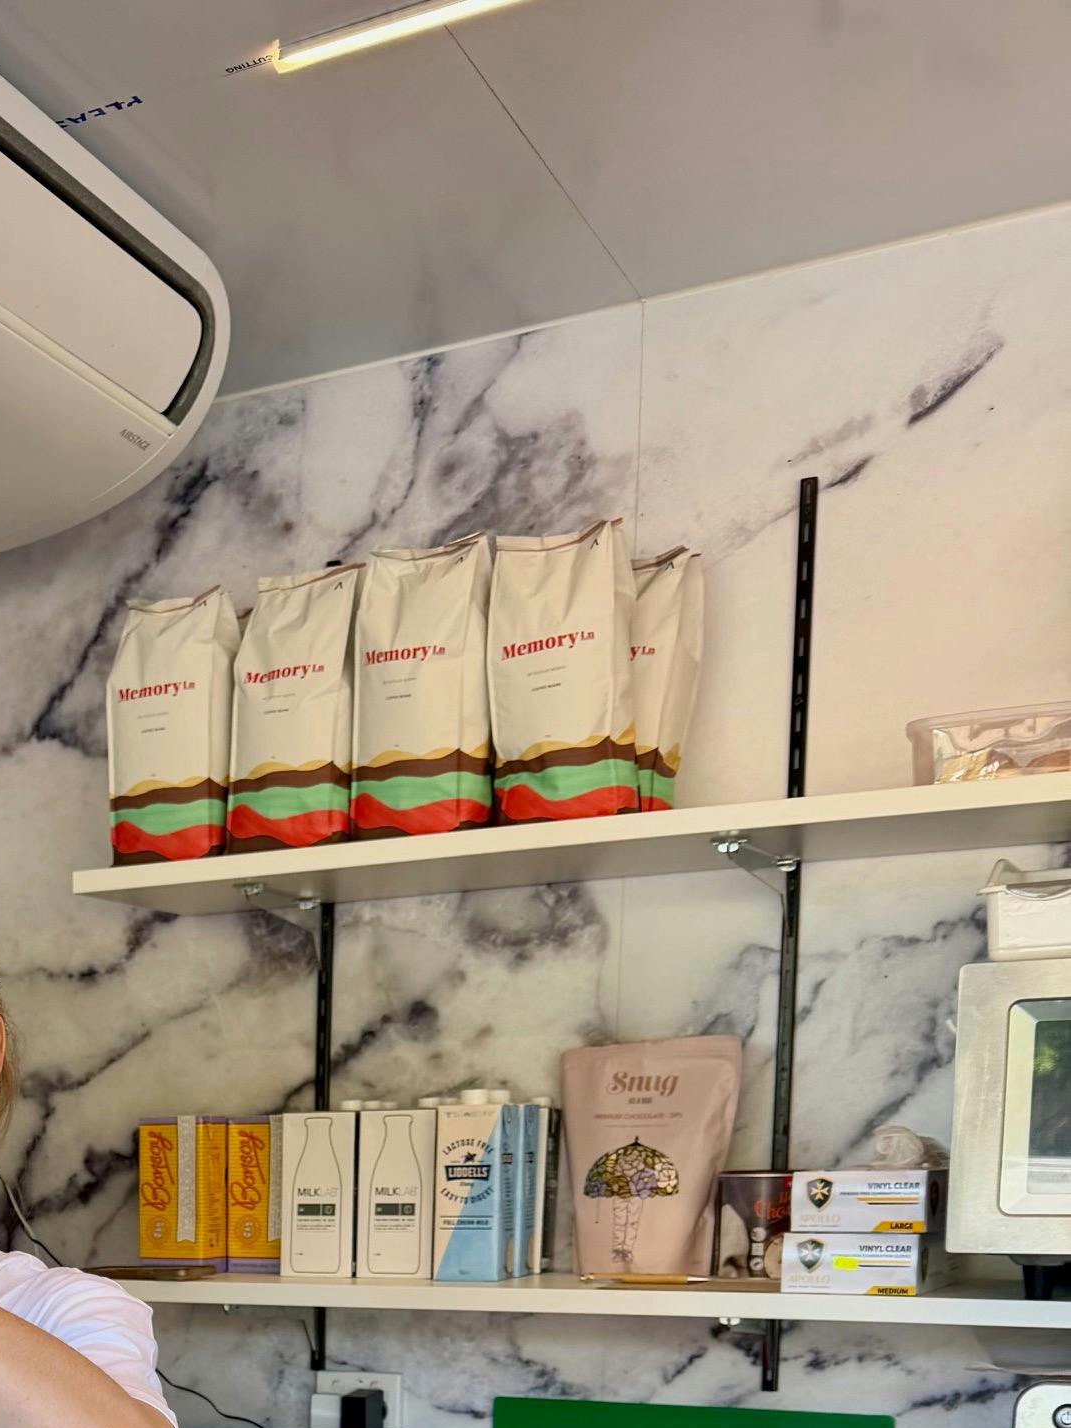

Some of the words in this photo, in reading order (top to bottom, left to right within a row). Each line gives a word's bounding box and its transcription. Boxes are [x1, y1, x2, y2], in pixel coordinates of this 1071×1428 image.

[225, 55, 274, 74] CUTTING
[365, 646, 431, 666] Memory
[501, 632, 580, 660] Memory
[243, 664, 310, 684] Memory
[117, 682, 181, 702] Memory
[606, 1071, 679, 1096] Snug
[141, 1131, 174, 1211] Bonsoy
[230, 1130, 266, 1211] Bonsoy
[448, 1166, 488, 1178] LIDDELLS
[868, 1182, 892, 1190] VINYL
[893, 1182, 921, 1190] CLEAR
[889, 1222, 914, 1231] LARGE
[859, 1245, 884, 1253] VINYL
[885, 1245, 912, 1253] CLEAR
